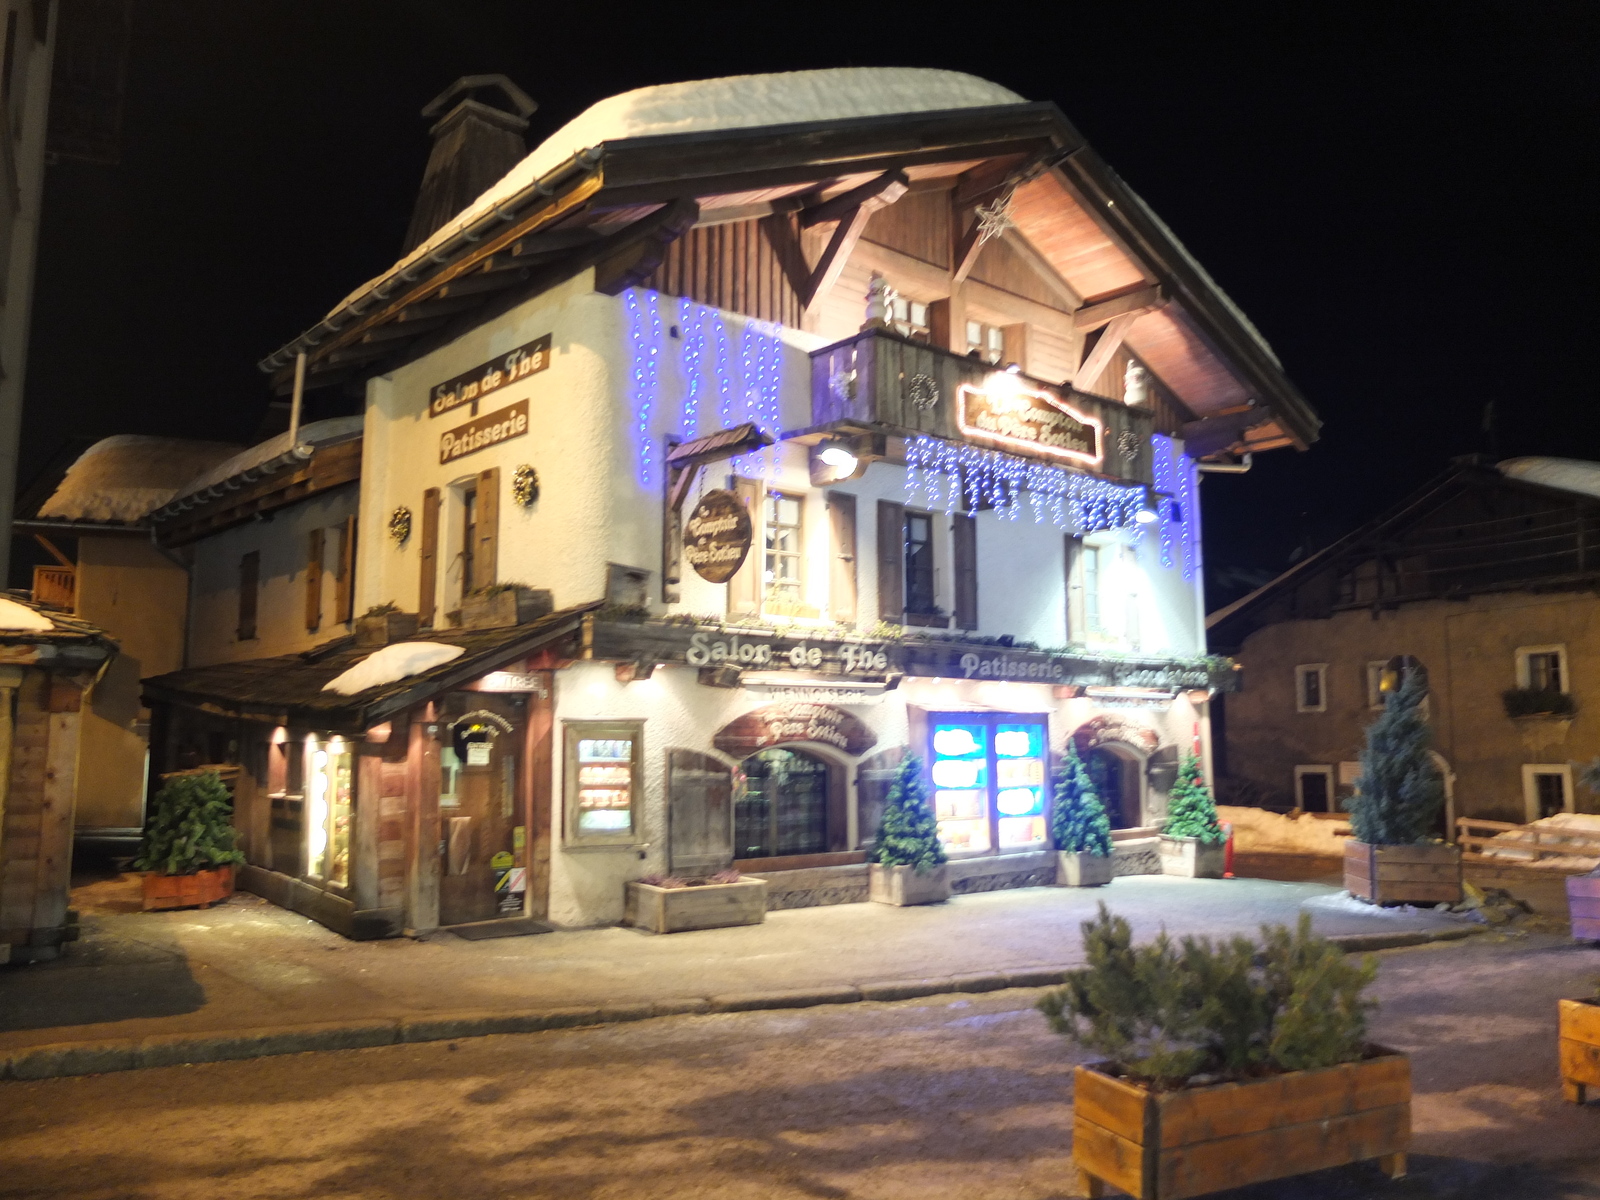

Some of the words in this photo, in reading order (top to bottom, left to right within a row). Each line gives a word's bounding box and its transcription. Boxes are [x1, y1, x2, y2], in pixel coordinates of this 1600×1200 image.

[433, 382, 479, 412] Salon
[481, 367, 501, 393] de
[505, 344, 542, 381] Thé
[441, 410, 527, 461] Patisserie
[686, 632, 772, 667] Salon
[789, 641, 822, 668] de
[838, 644, 888, 673] Thé
[960, 653, 1064, 679] Patisserie
